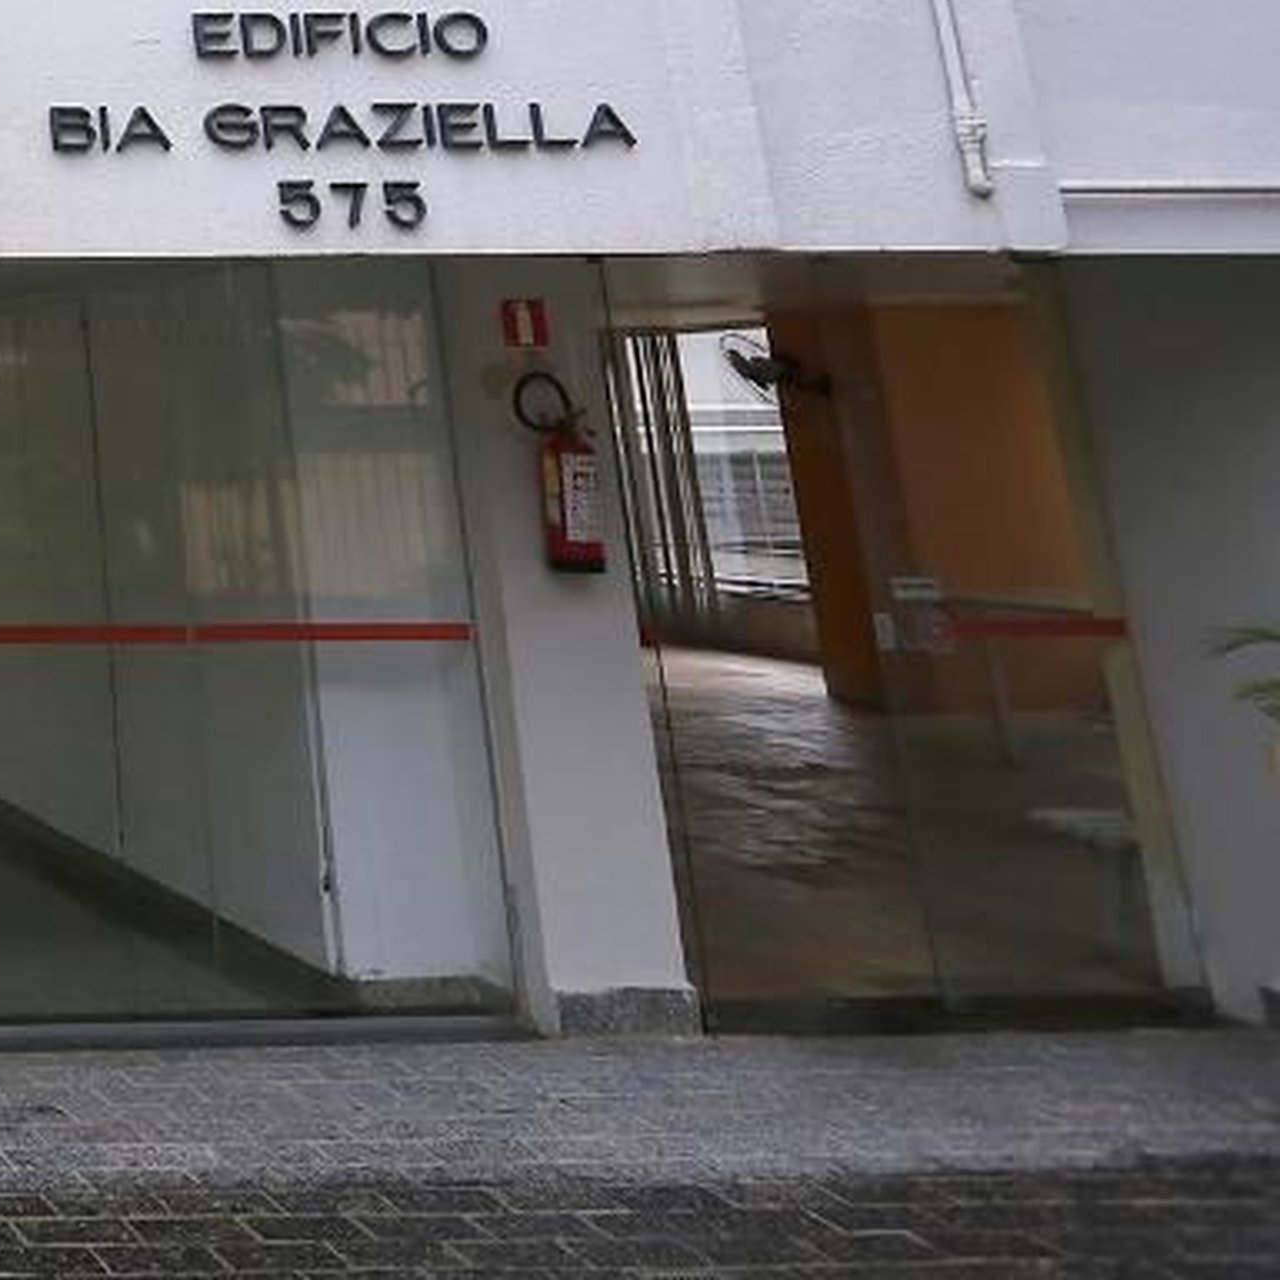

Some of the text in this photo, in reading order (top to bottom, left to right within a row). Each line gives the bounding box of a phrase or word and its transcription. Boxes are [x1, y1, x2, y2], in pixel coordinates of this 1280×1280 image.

[190, 12, 490, 61] EDIFICIO
[49, 103, 639, 154] BIA GRAZIELLA
[276, 179, 429, 231] 575
